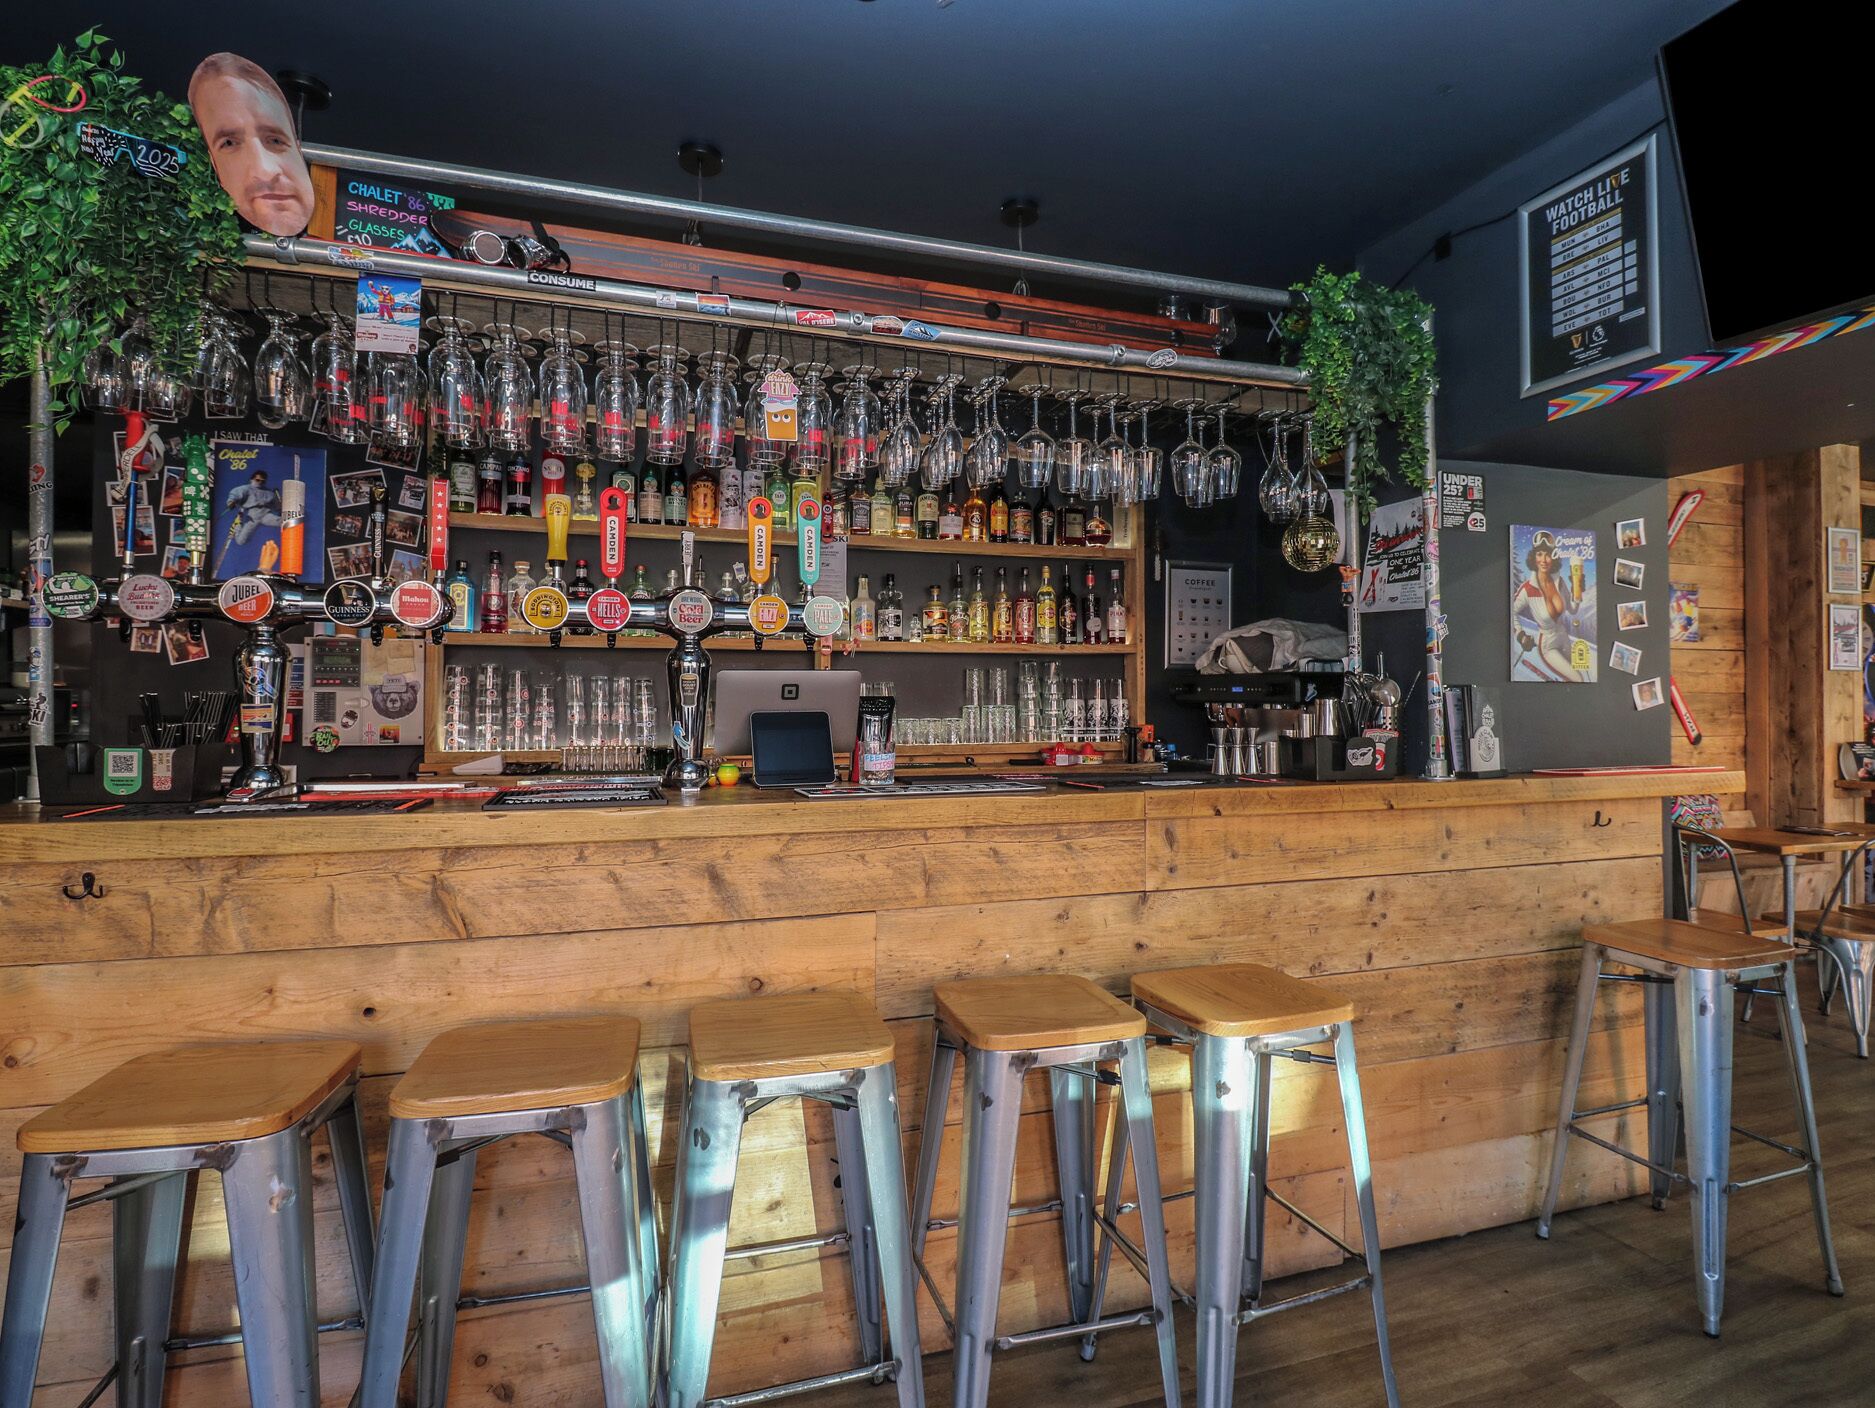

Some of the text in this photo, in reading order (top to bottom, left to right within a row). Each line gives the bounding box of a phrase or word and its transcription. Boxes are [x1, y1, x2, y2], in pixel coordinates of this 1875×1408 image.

[137, 144, 180, 174] 2025
[348, 182, 402, 205] CHALET
[1546, 186, 1594, 222] WATCH
[347, 201, 428, 225] SHREDDER
[1552, 189, 1624, 235] FOOTBALL
[348, 219, 405, 240] GLASSES
[1561, 238, 1576, 249] MUN
[1562, 235, 1609, 262] BRE LIV
[1562, 254, 1610, 280] ARS PAL
[529, 272, 595, 290] CONSUME
[1562, 267, 1610, 292] AVL MCI
[1563, 295, 1576, 305] BOU
[1563, 307, 1576, 318] WOL
[1564, 320, 1576, 331] EVE
[1598, 307, 1611, 318] TOT
[768, 373, 792, 382] drink
[771, 382, 790, 396] EAZY
[219, 430, 243, 441] SAW
[245, 432, 268, 443] THAT
[218, 448, 259, 460] Chalet
[230, 459, 248, 470] '86
[1443, 473, 1483, 487] UNDER
[1443, 484, 1463, 496] 25?
[1473, 518, 1485, 528] 25
[374, 528, 382, 558] GUINNESS
[609, 519, 617, 561] CAMDEN
[1555, 535, 1593, 547] Cream of
[684, 540, 692, 557] JERRY
[1551, 545, 1595, 560] Chalet '86
[1389, 555, 1421, 566] ONE YEAR
[132, 583, 158, 592] Lucky
[1184, 578, 1216, 587] COFFEE
[49, 592, 91, 602] SHEARER'S
[232, 584, 260, 603] JUBEL
[402, 595, 429, 603] Mahou
[238, 599, 257, 611] BEER
[328, 605, 371, 614] GUINNESS
[597, 603, 621, 618] HELLS
[678, 603, 704, 614] Cold
[679, 614, 704, 624] Beer
[759, 608, 777, 621] EAZY
[814, 609, 832, 624] PALE
[865, 753, 895, 762] FEELIN
